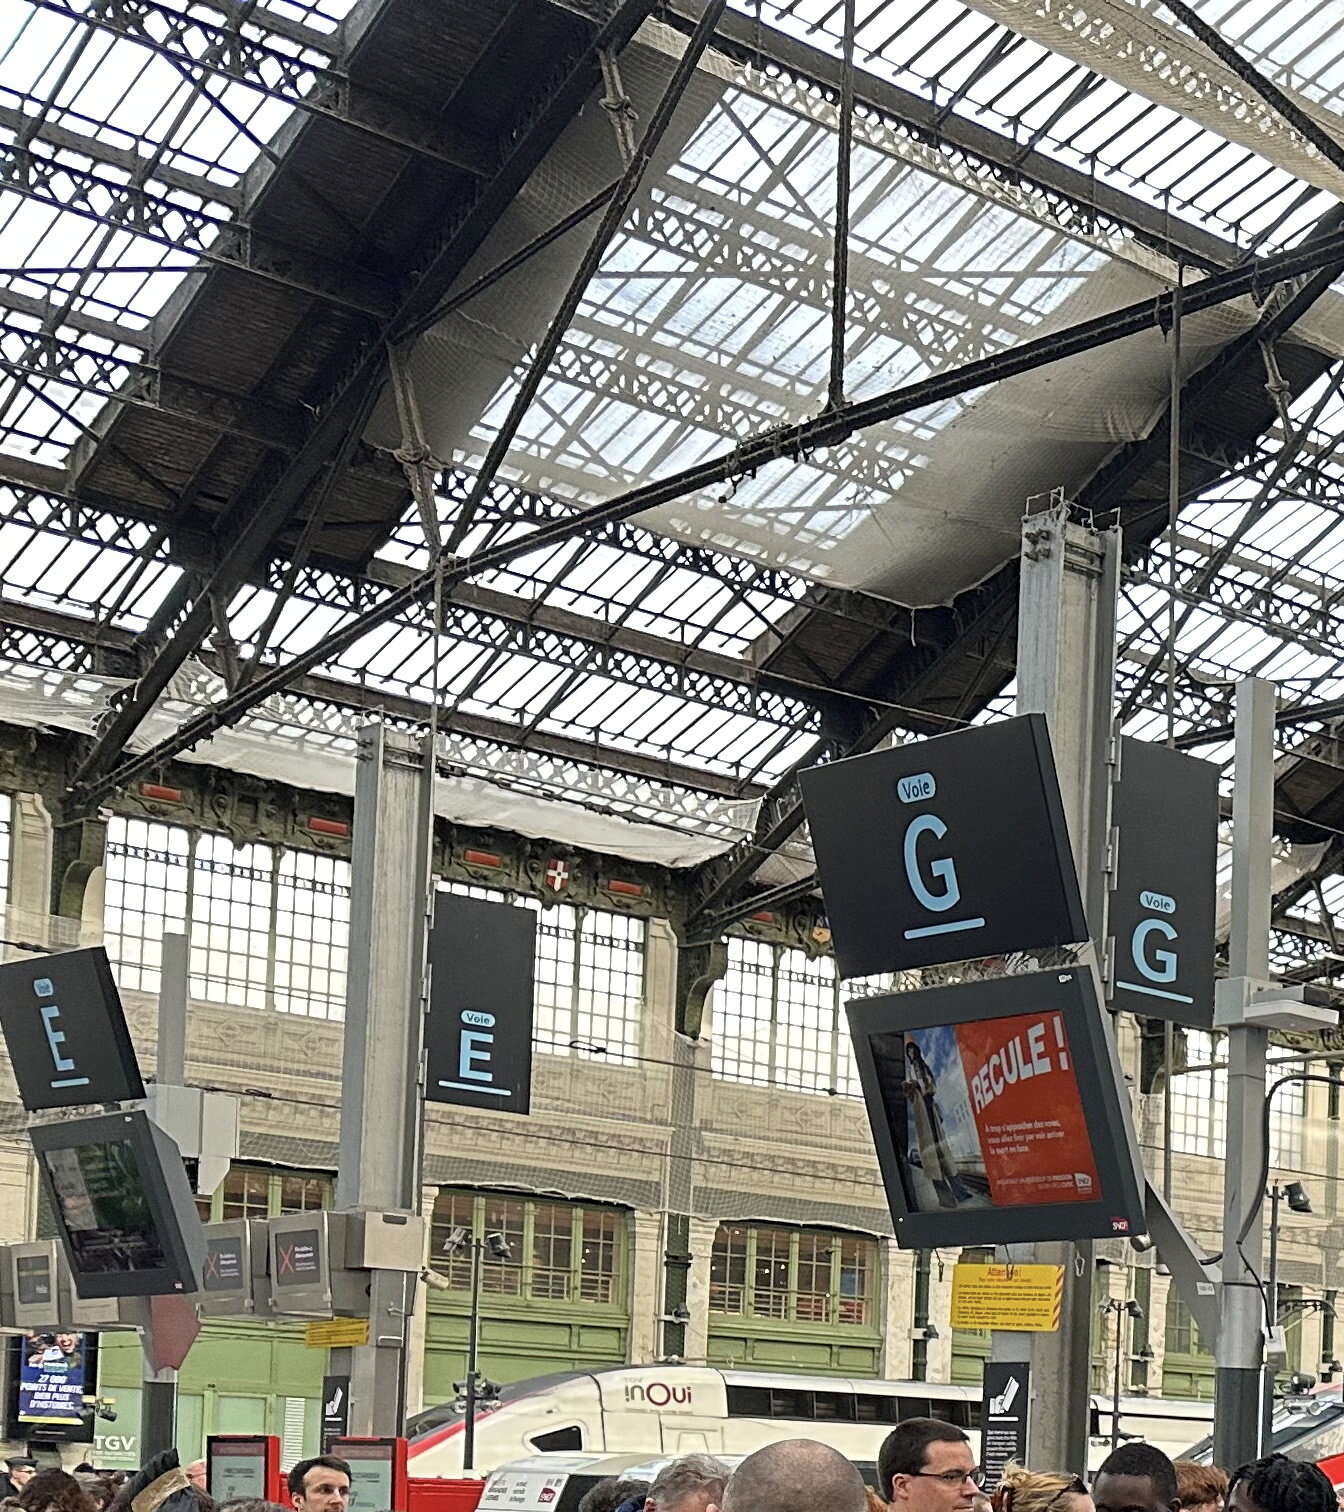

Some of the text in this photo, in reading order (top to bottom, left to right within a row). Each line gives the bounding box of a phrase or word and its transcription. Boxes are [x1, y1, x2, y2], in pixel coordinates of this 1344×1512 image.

[902, 779, 930, 800] Voie
[904, 814, 961, 911] G
[1145, 894, 1172, 912] Voie
[1132, 918, 1178, 983] G
[41, 1006, 75, 1071] E
[465, 1013, 490, 1026] Voie
[459, 1029, 494, 1082] E
[971, 1016, 1069, 1114] RECULE !
[94, 1435, 137, 1451] TGV
